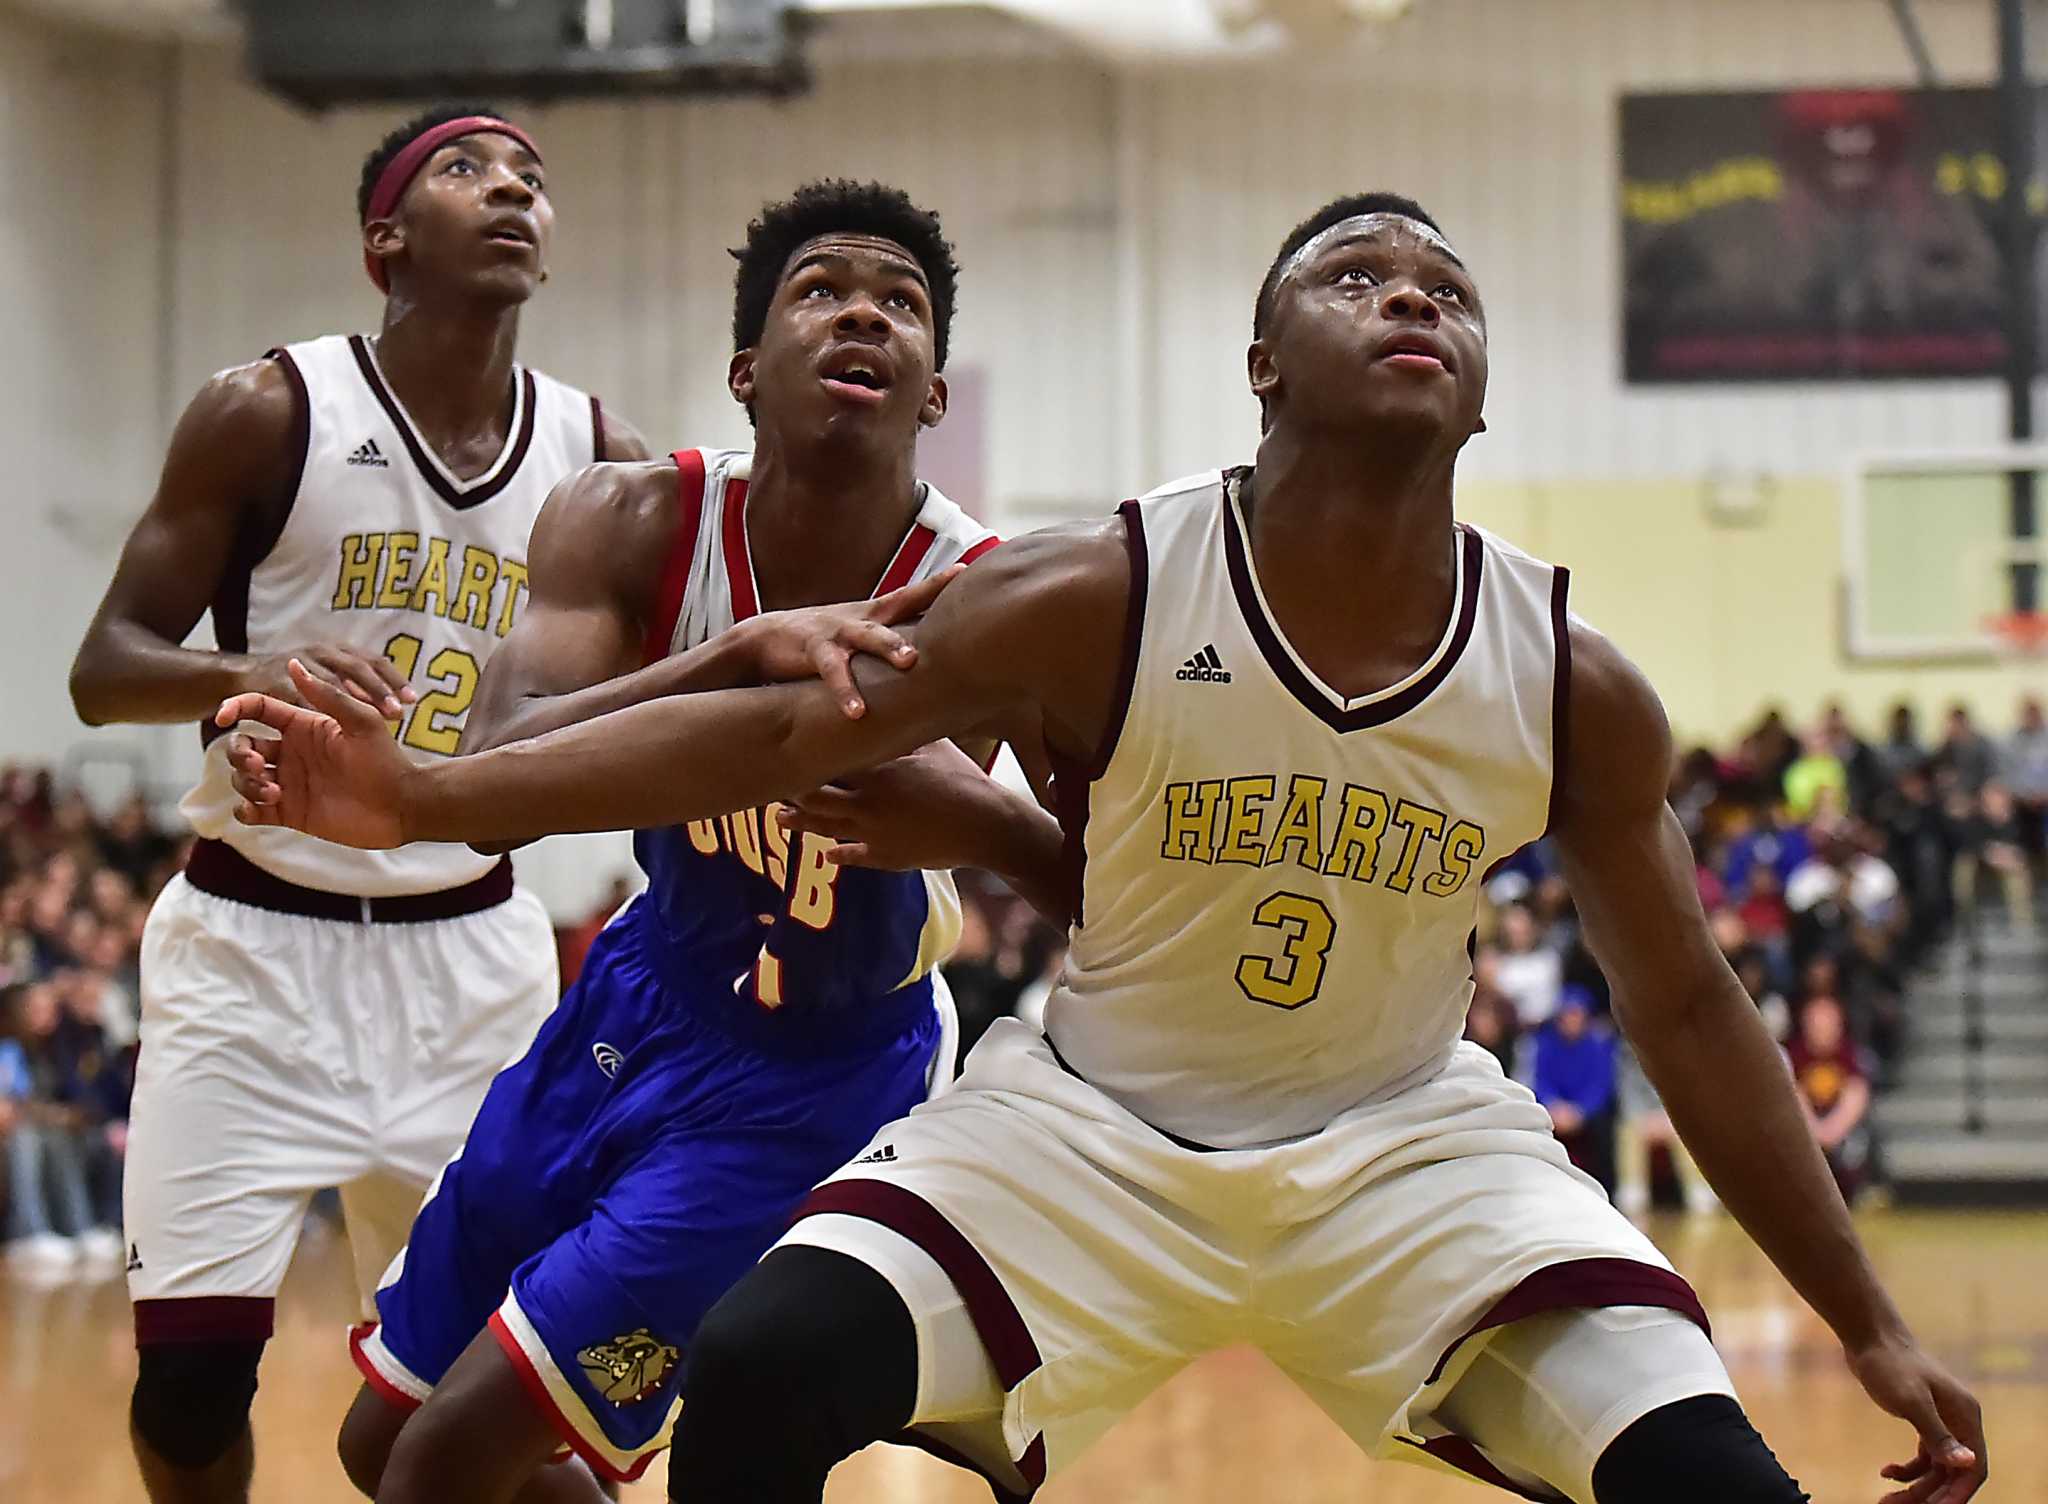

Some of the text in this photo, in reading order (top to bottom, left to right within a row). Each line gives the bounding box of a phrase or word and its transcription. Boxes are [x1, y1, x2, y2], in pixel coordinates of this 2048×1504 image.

[1175, 666, 1232, 684] adidas
[1161, 772, 1485, 898] HEARTS
[1234, 890, 1337, 1011] 3
